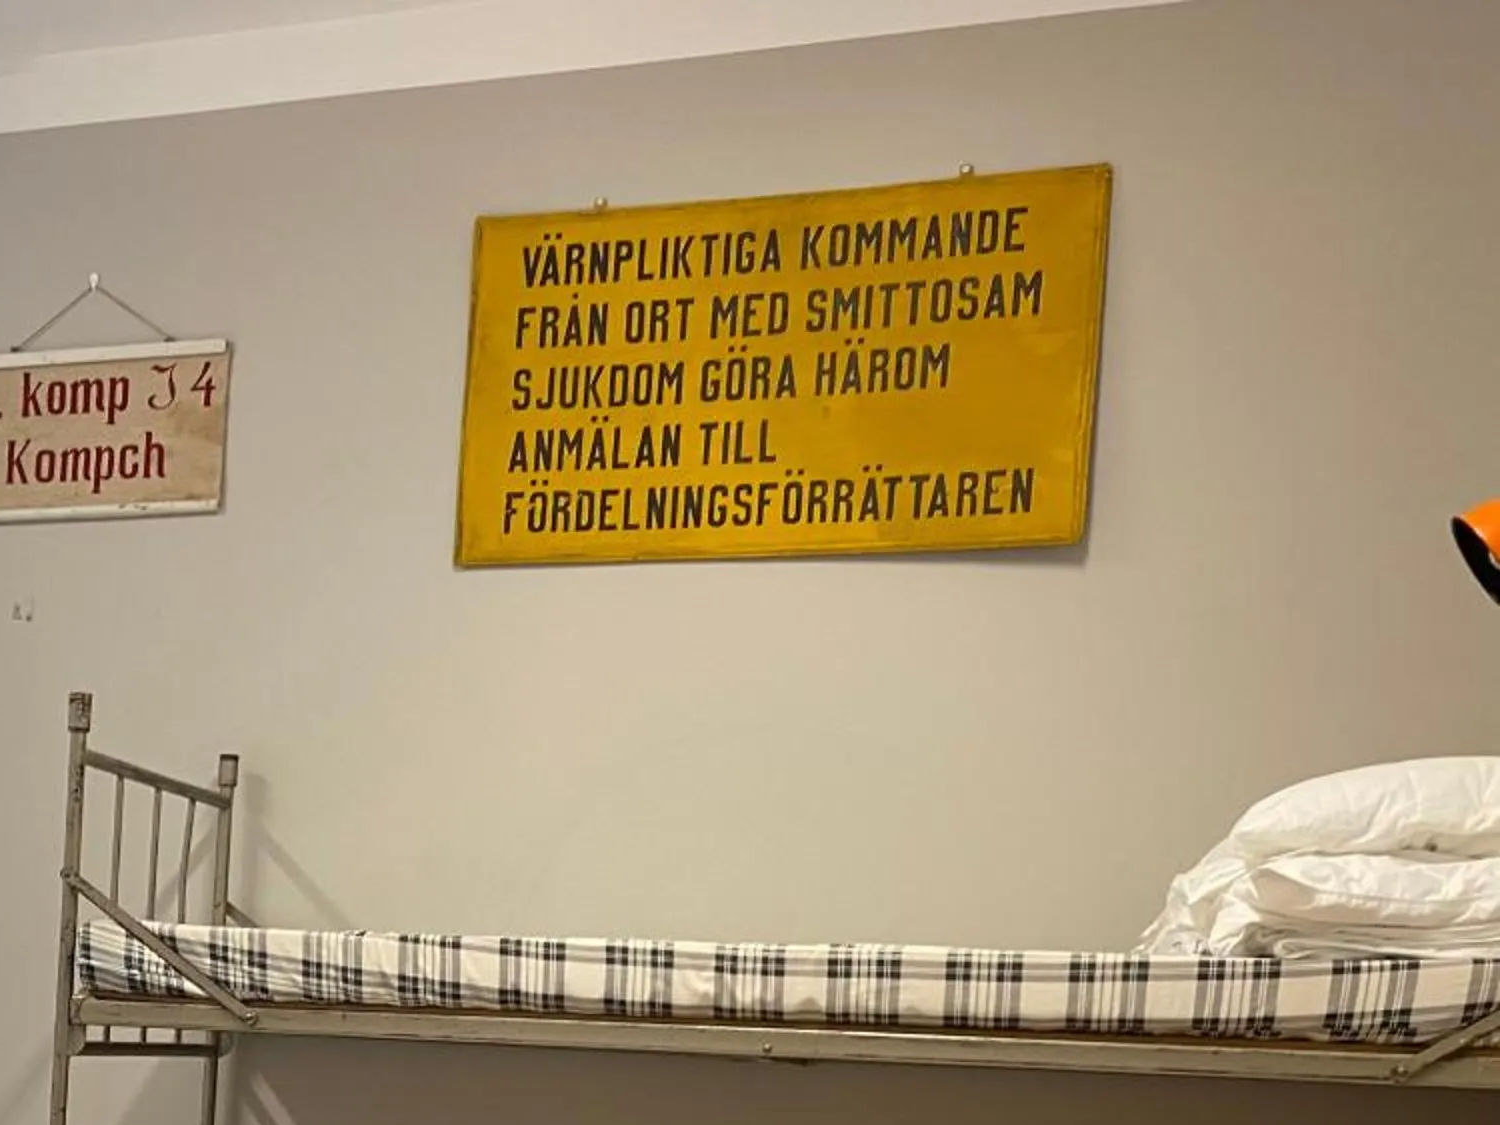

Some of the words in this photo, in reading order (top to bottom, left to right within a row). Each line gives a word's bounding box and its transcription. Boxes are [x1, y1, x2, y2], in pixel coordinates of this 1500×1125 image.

[522, 228, 782, 288] VÄRNPLIKTIGA
[800, 206, 1029, 271] KOMMANDE
[515, 293, 607, 349] FRÅN
[624, 297, 695, 344] ORT
[709, 291, 789, 340] MED
[805, 270, 1044, 334] SMITTOSAM
[21, 372, 130, 425] komp
[190, 361, 216, 407] 4
[511, 360, 684, 410] SJUKDOM
[700, 345, 796, 403] GÖRA
[813, 338, 952, 396] HÄROM
[6, 432, 166, 494] Kompch
[507, 416, 681, 473] ANMÄLAN
[699, 418, 777, 465] TILL
[502, 464, 1035, 535] FÖRDELNINGSFÖRRÄTTAREN
